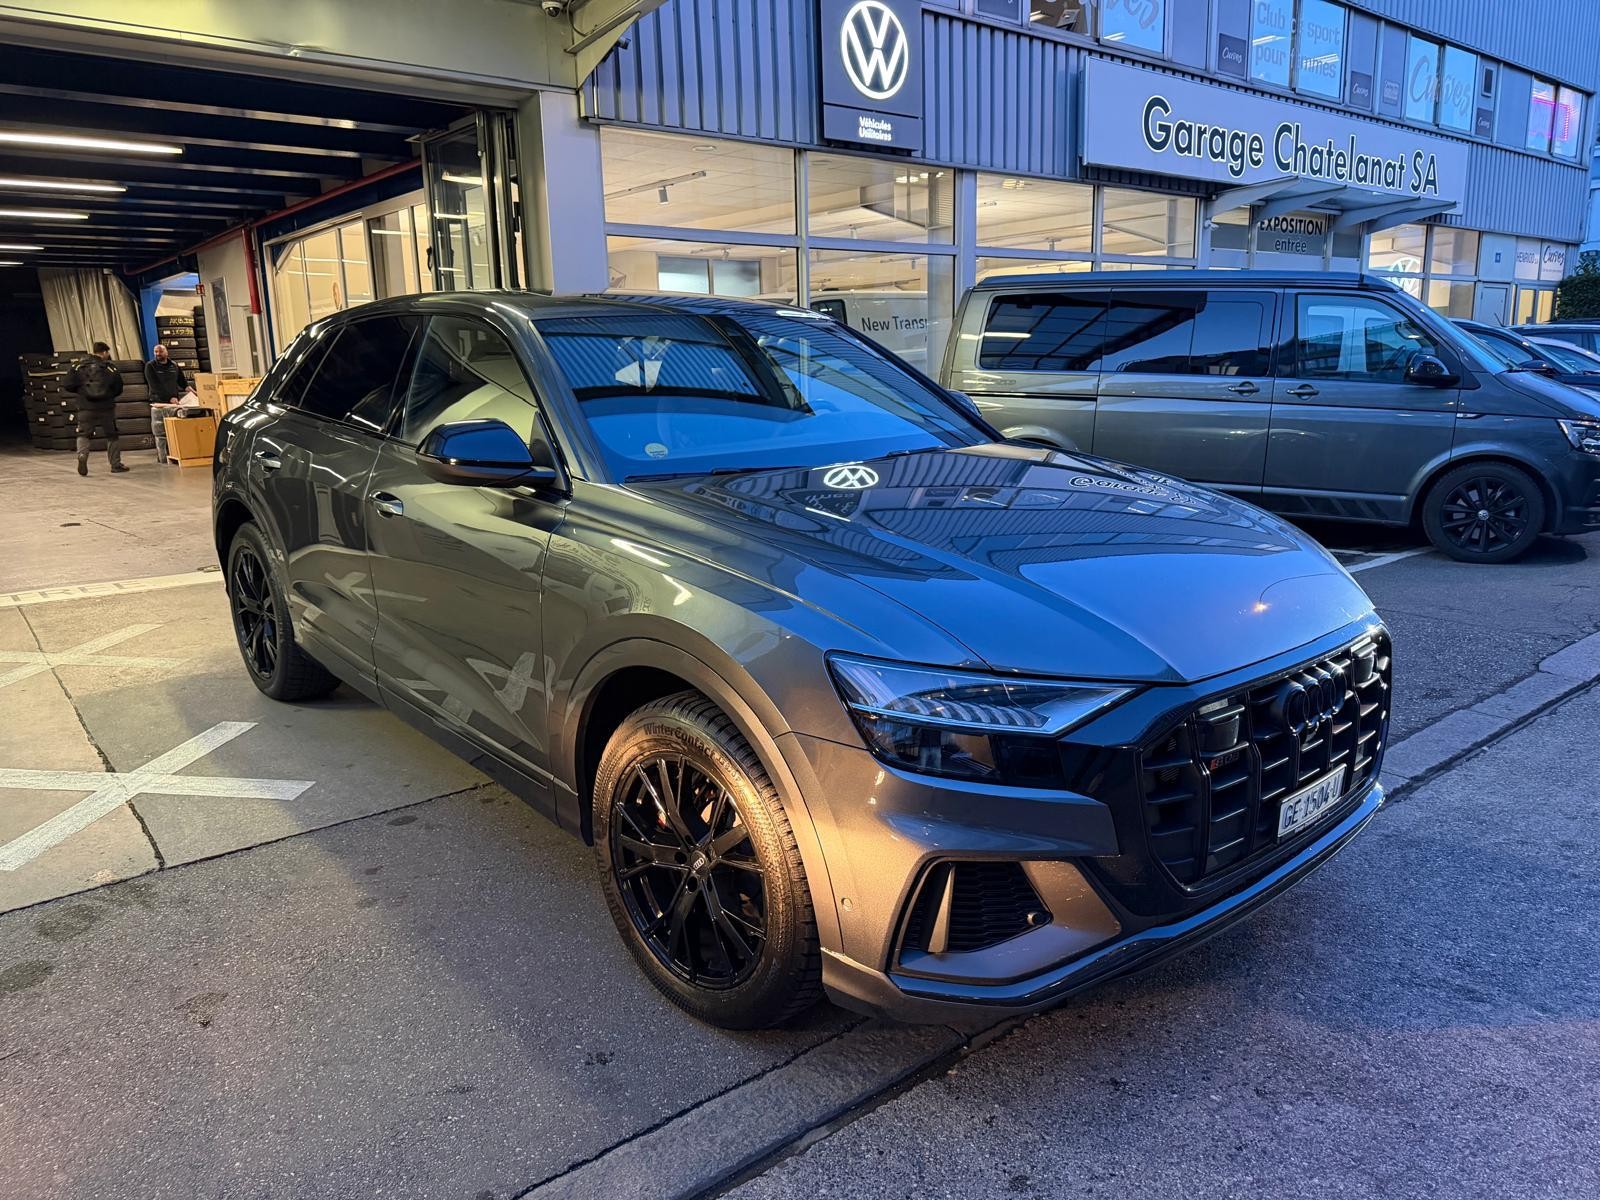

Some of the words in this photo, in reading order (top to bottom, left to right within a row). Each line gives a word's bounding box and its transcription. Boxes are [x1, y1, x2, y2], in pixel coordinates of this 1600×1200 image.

[1257, 2, 1285, 29] Club
[1307, 22, 1339, 45] sport
[1255, 46, 1287, 66] pour
[1143, 95, 1265, 178] Garage
[1273, 121, 1407, 191] Chatelanat
[1410, 149, 1439, 196] SA
[1260, 215, 1324, 236] EXPOSITION
[1274, 238, 1307, 253] entrée
[861, 317, 890, 332] New
